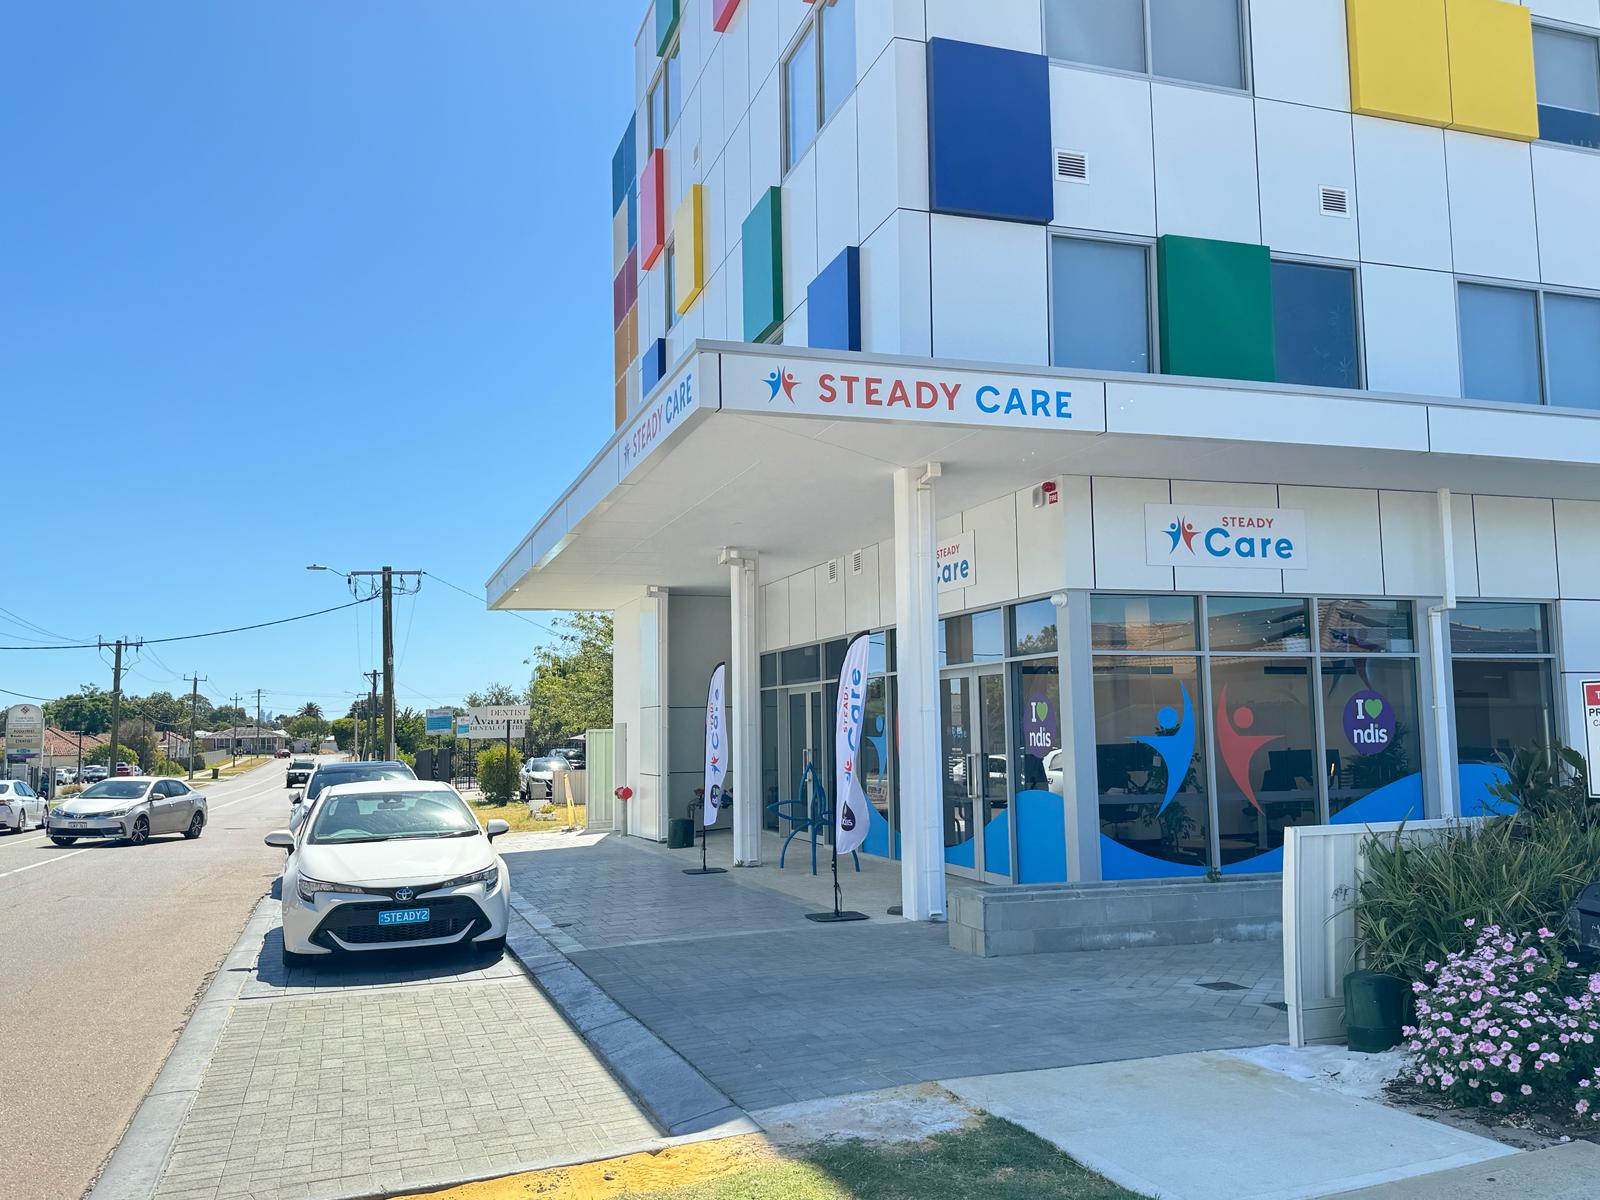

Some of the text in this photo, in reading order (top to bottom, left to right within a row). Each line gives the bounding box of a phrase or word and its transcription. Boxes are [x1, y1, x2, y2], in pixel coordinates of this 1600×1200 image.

[818, 373, 1073, 419] STEADY CARE
[632, 373, 692, 458] STEADY CARE
[1222, 516, 1274, 529] STEADY
[936, 543, 960, 559] STEADY
[1204, 527, 1294, 559] Care
[1031, 701, 1037, 723] I
[1356, 699, 1365, 720] I
[1029, 727, 1052, 747] ndis
[1353, 723, 1388, 744] ndis
[384, 910, 428, 923] STEADY2
